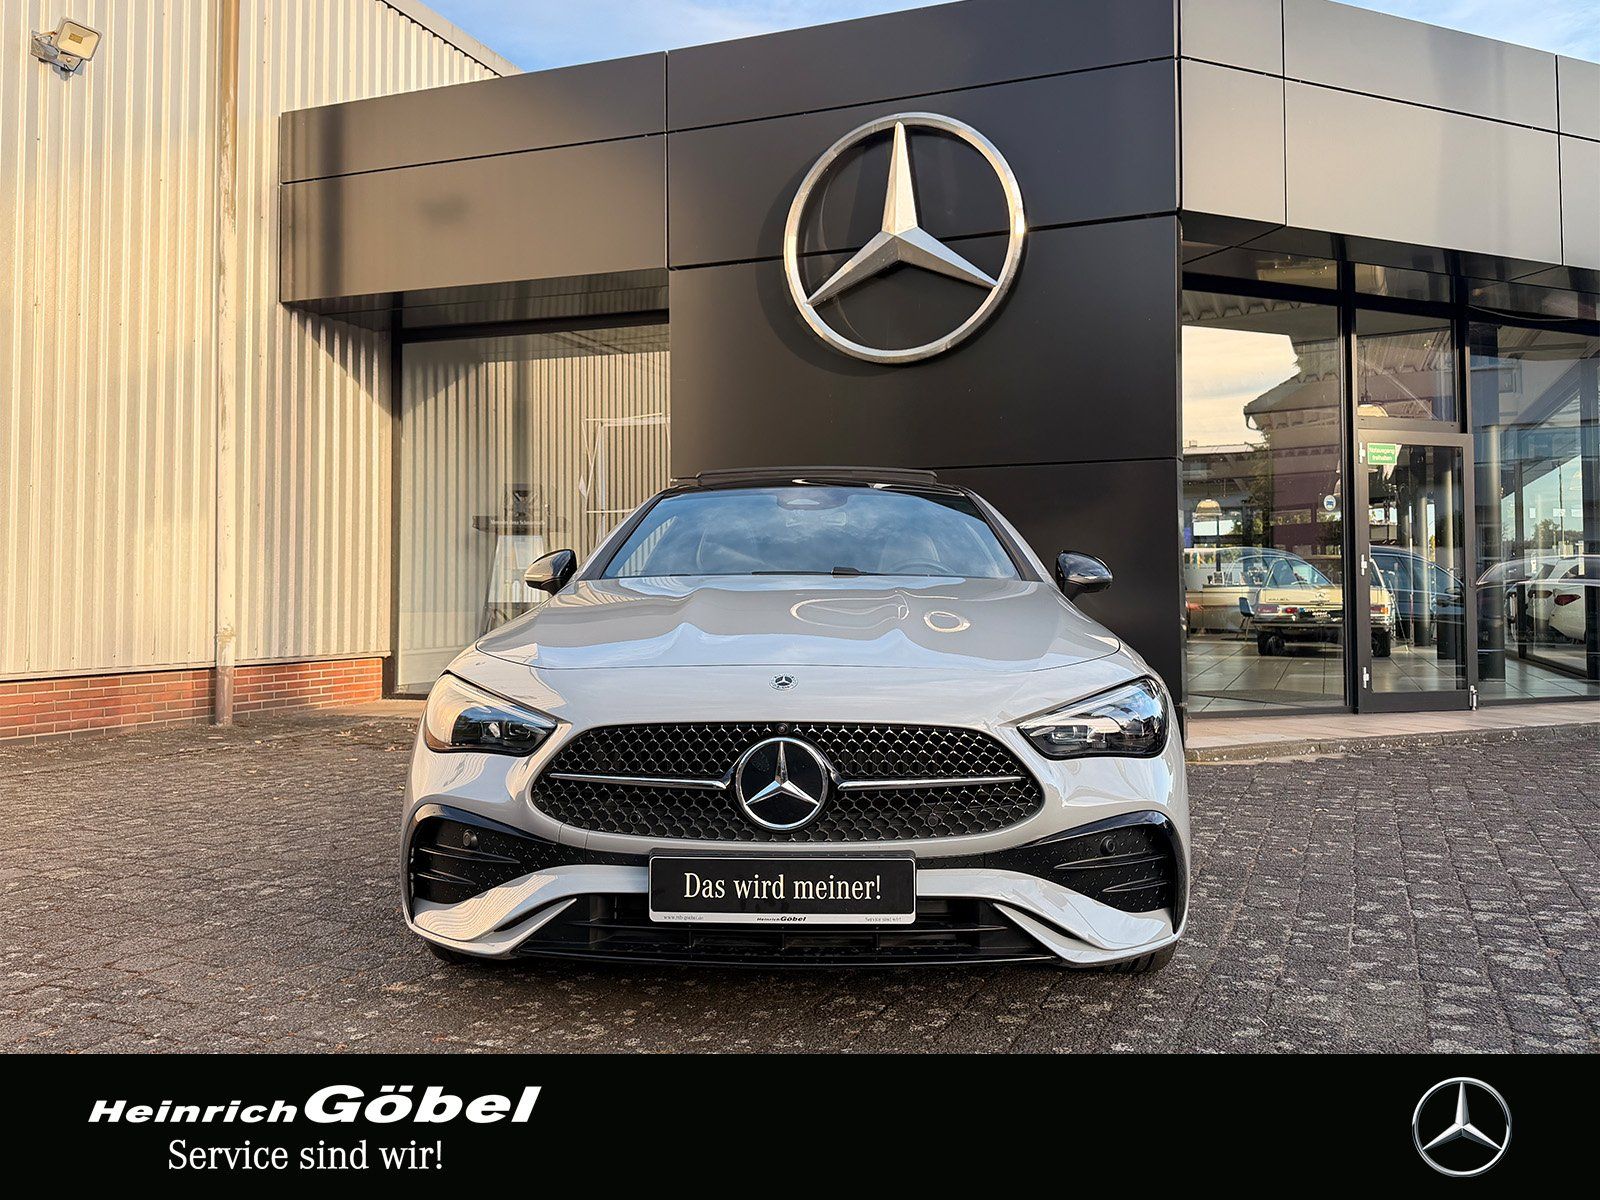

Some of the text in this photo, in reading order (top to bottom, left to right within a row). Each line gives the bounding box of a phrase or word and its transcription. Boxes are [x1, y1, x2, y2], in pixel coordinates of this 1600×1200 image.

[683, 872, 881, 900] Das wird meiner!
